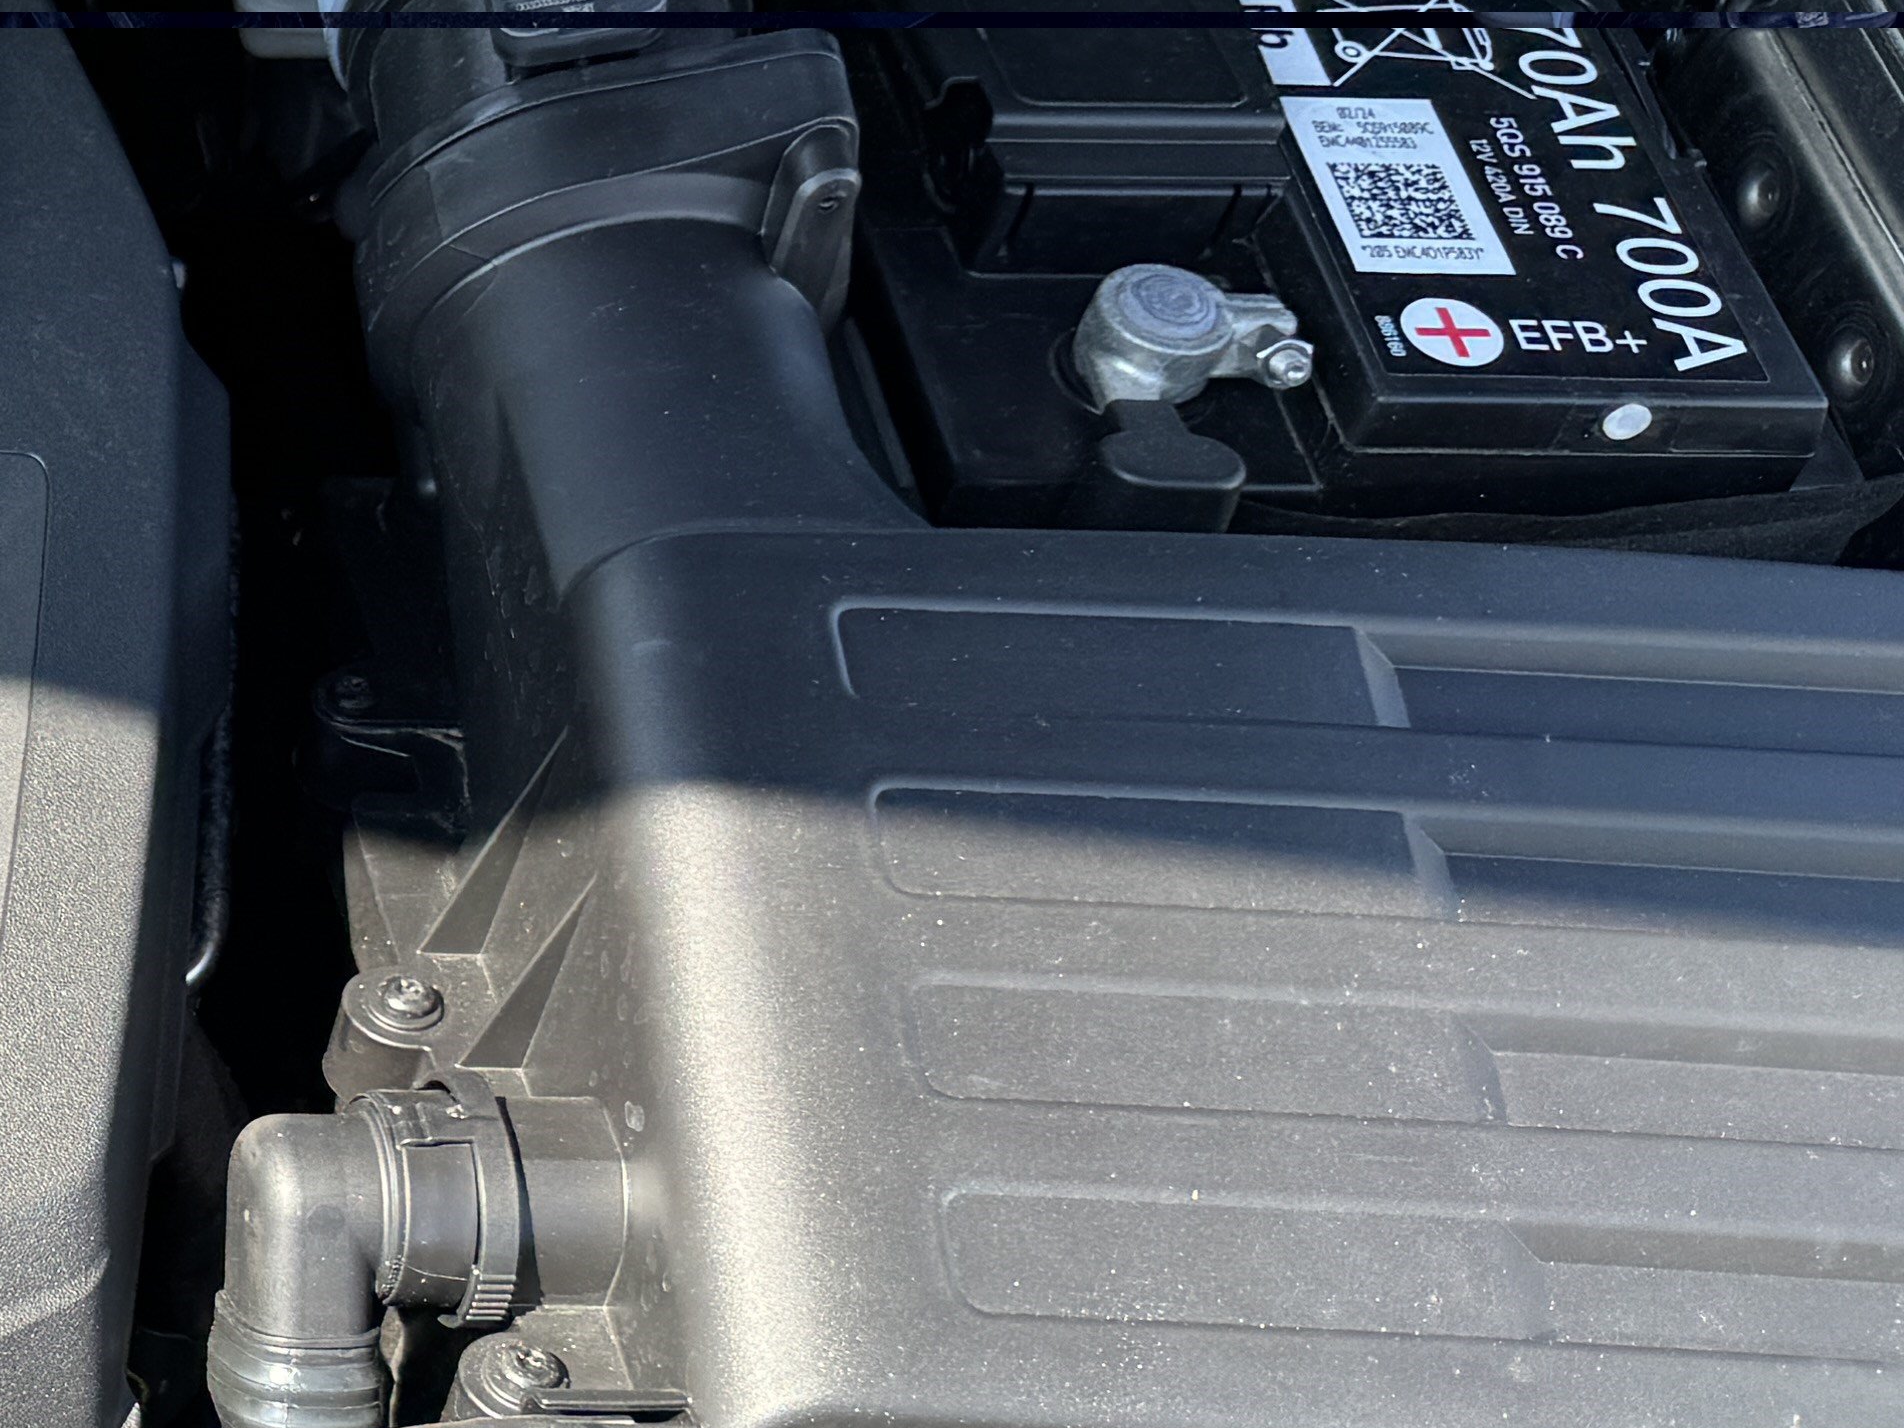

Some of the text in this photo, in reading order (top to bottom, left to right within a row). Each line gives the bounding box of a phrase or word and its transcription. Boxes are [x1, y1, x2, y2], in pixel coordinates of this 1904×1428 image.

[1469, 139, 1498, 164] 12V
[1502, 207, 1535, 235] DIN
[1490, 117, 1584, 260] 5QS 915 089 C
[1514, 26, 1748, 372] 70Ah 700A
[1508, 318, 1648, 354] EFB+
